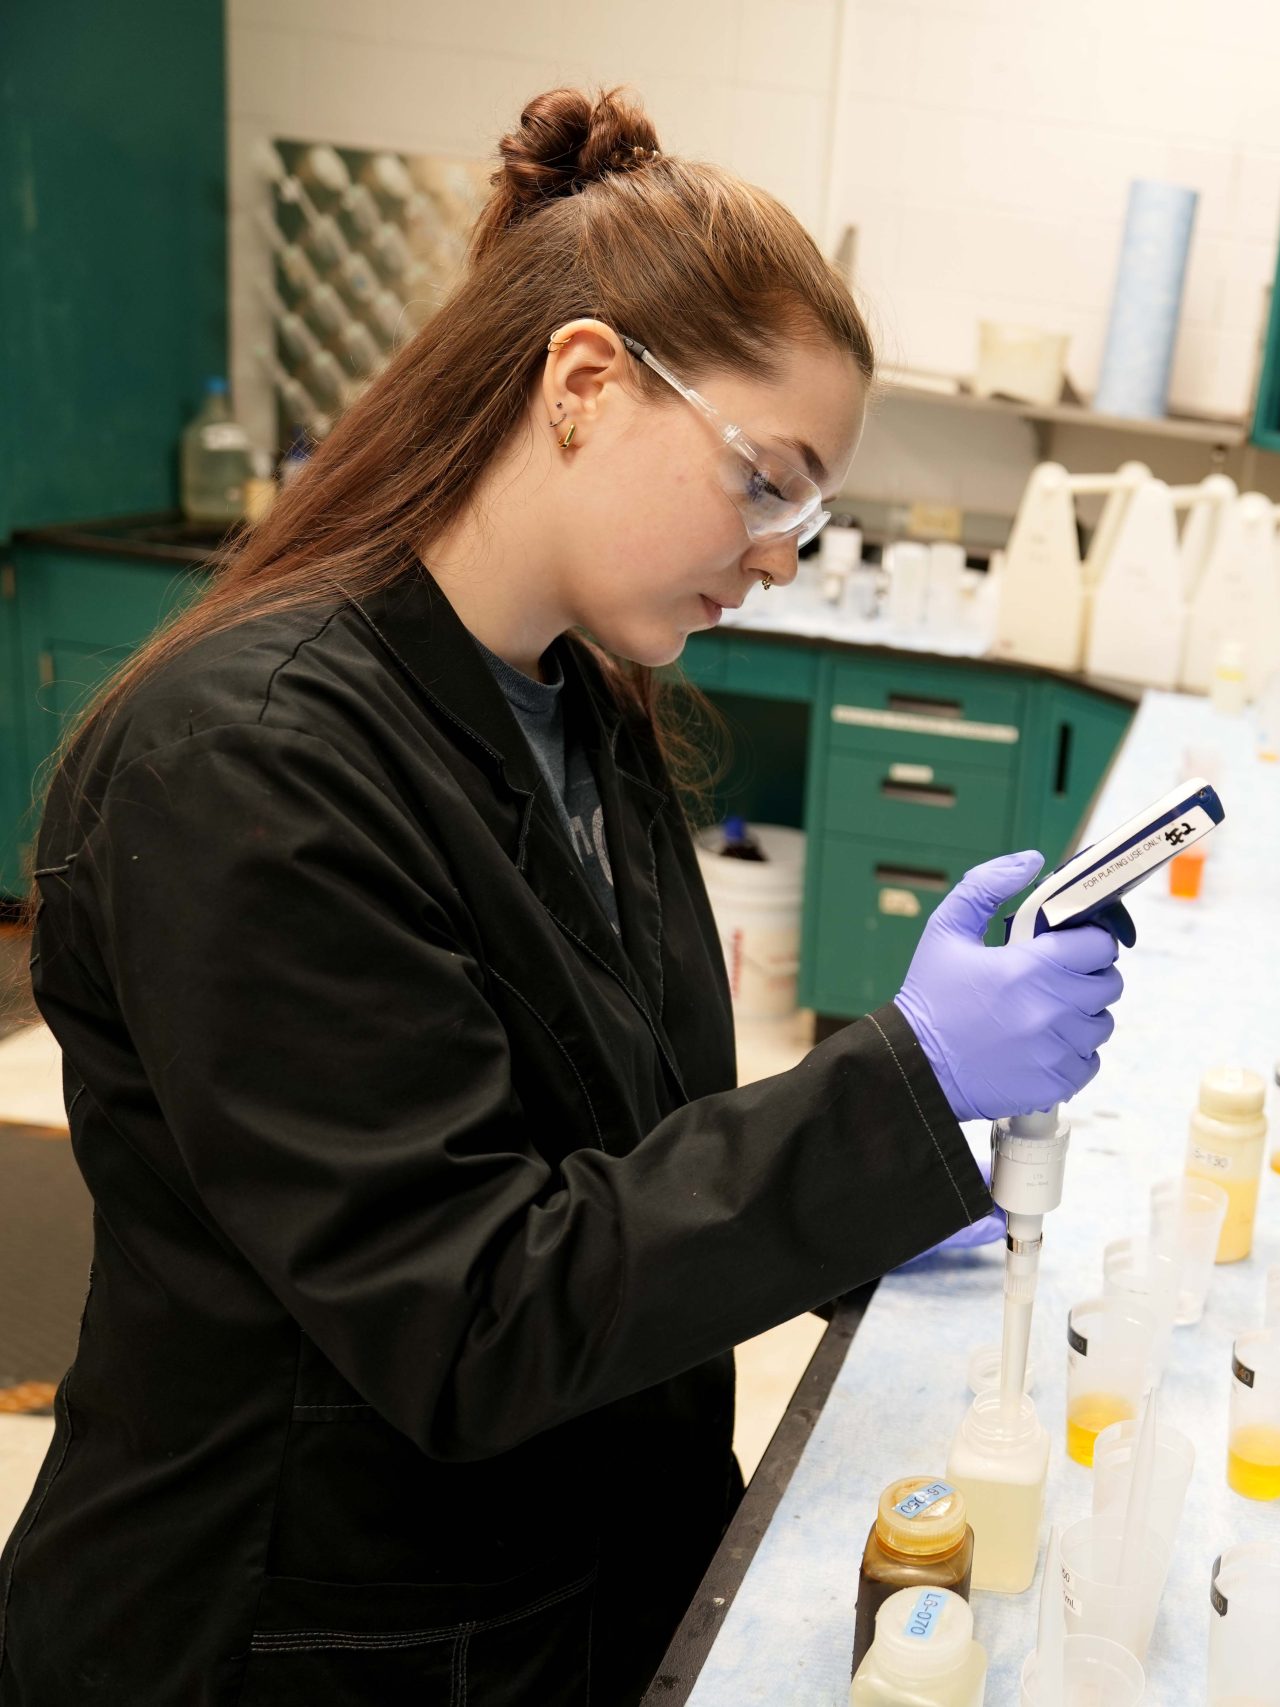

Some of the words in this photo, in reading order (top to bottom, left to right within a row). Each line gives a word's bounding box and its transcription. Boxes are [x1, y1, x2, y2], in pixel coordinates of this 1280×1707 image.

[1083, 876, 1100, 890] FOR
[1099, 858, 1128, 883] PLATING
[1127, 849, 1143, 864] USE
[1143, 834, 1162, 852] ONLY
[910, 1593, 942, 1635] L6-070
